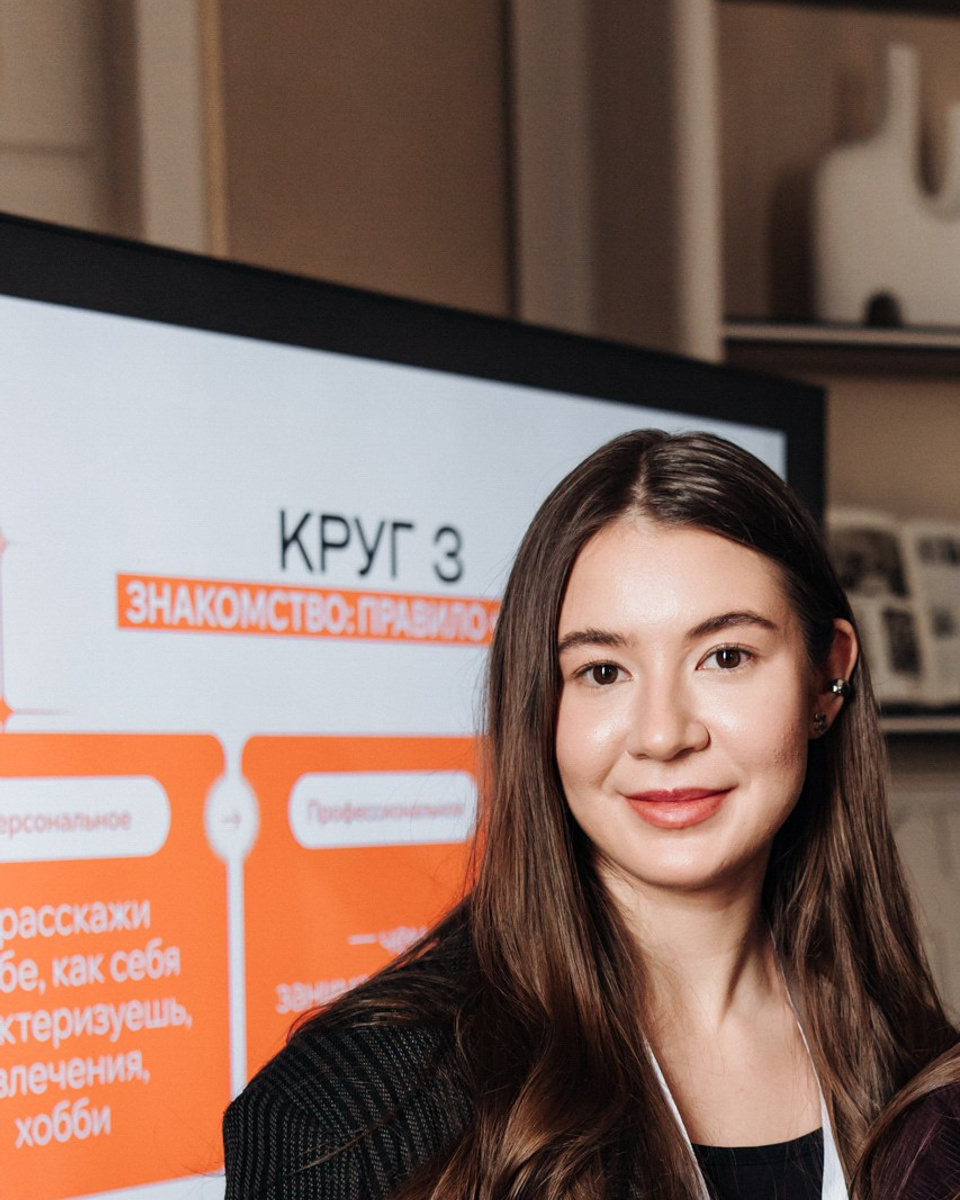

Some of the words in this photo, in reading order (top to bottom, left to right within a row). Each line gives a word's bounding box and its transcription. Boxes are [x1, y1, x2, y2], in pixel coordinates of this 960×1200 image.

[279, 509, 415, 579] КРУГ
[433, 524, 466, 584] 3
[126, 580, 355, 635] ЗНАКОМСТВО:
[52, 953, 104, 988] как
[109, 938, 181, 981] себя
[15, 1097, 112, 1148] хобби
